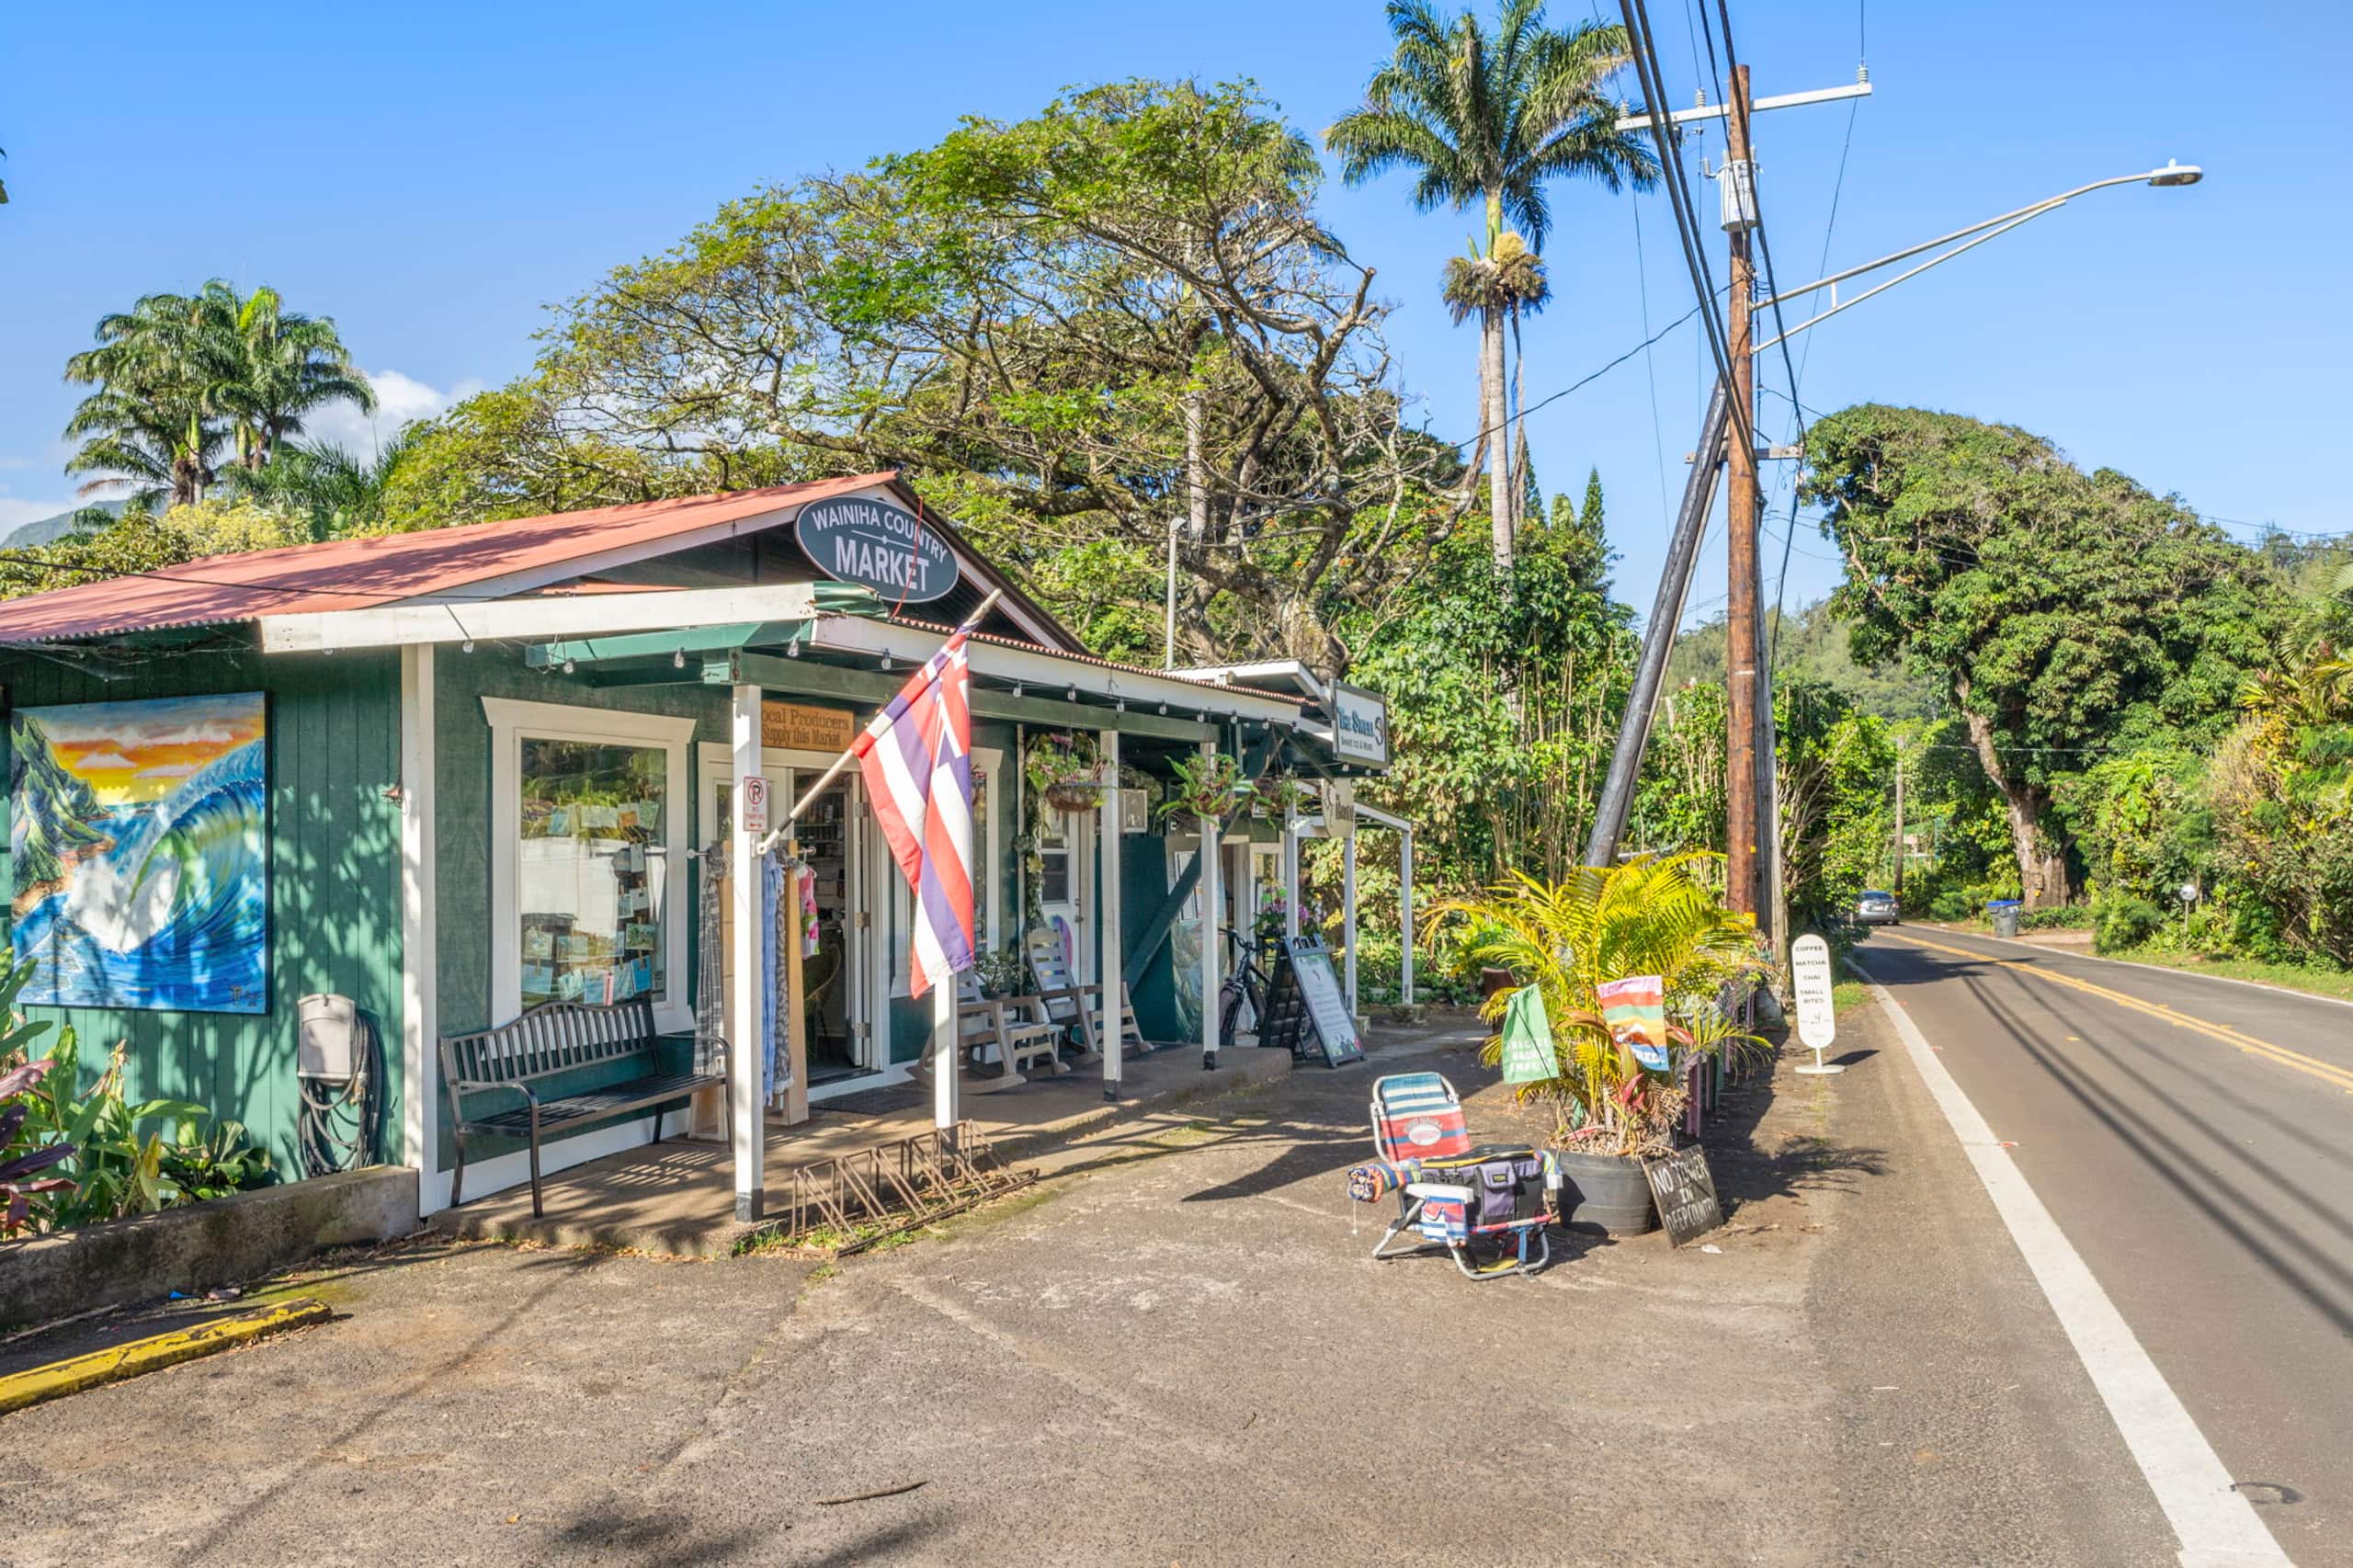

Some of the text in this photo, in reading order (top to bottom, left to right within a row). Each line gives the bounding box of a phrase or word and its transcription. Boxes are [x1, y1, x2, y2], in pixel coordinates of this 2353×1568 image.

[812, 505, 948, 563] WAINIHA COUNTRY
[835, 535, 929, 592] MARKET
[762, 708, 849, 731] ocal Producers
[762, 723, 841, 746] Supply this Market
[1652, 1153, 1711, 1197] NO TOWER
[1679, 1186, 1695, 1204] IN
[1665, 1206, 1688, 1236] DEEP
